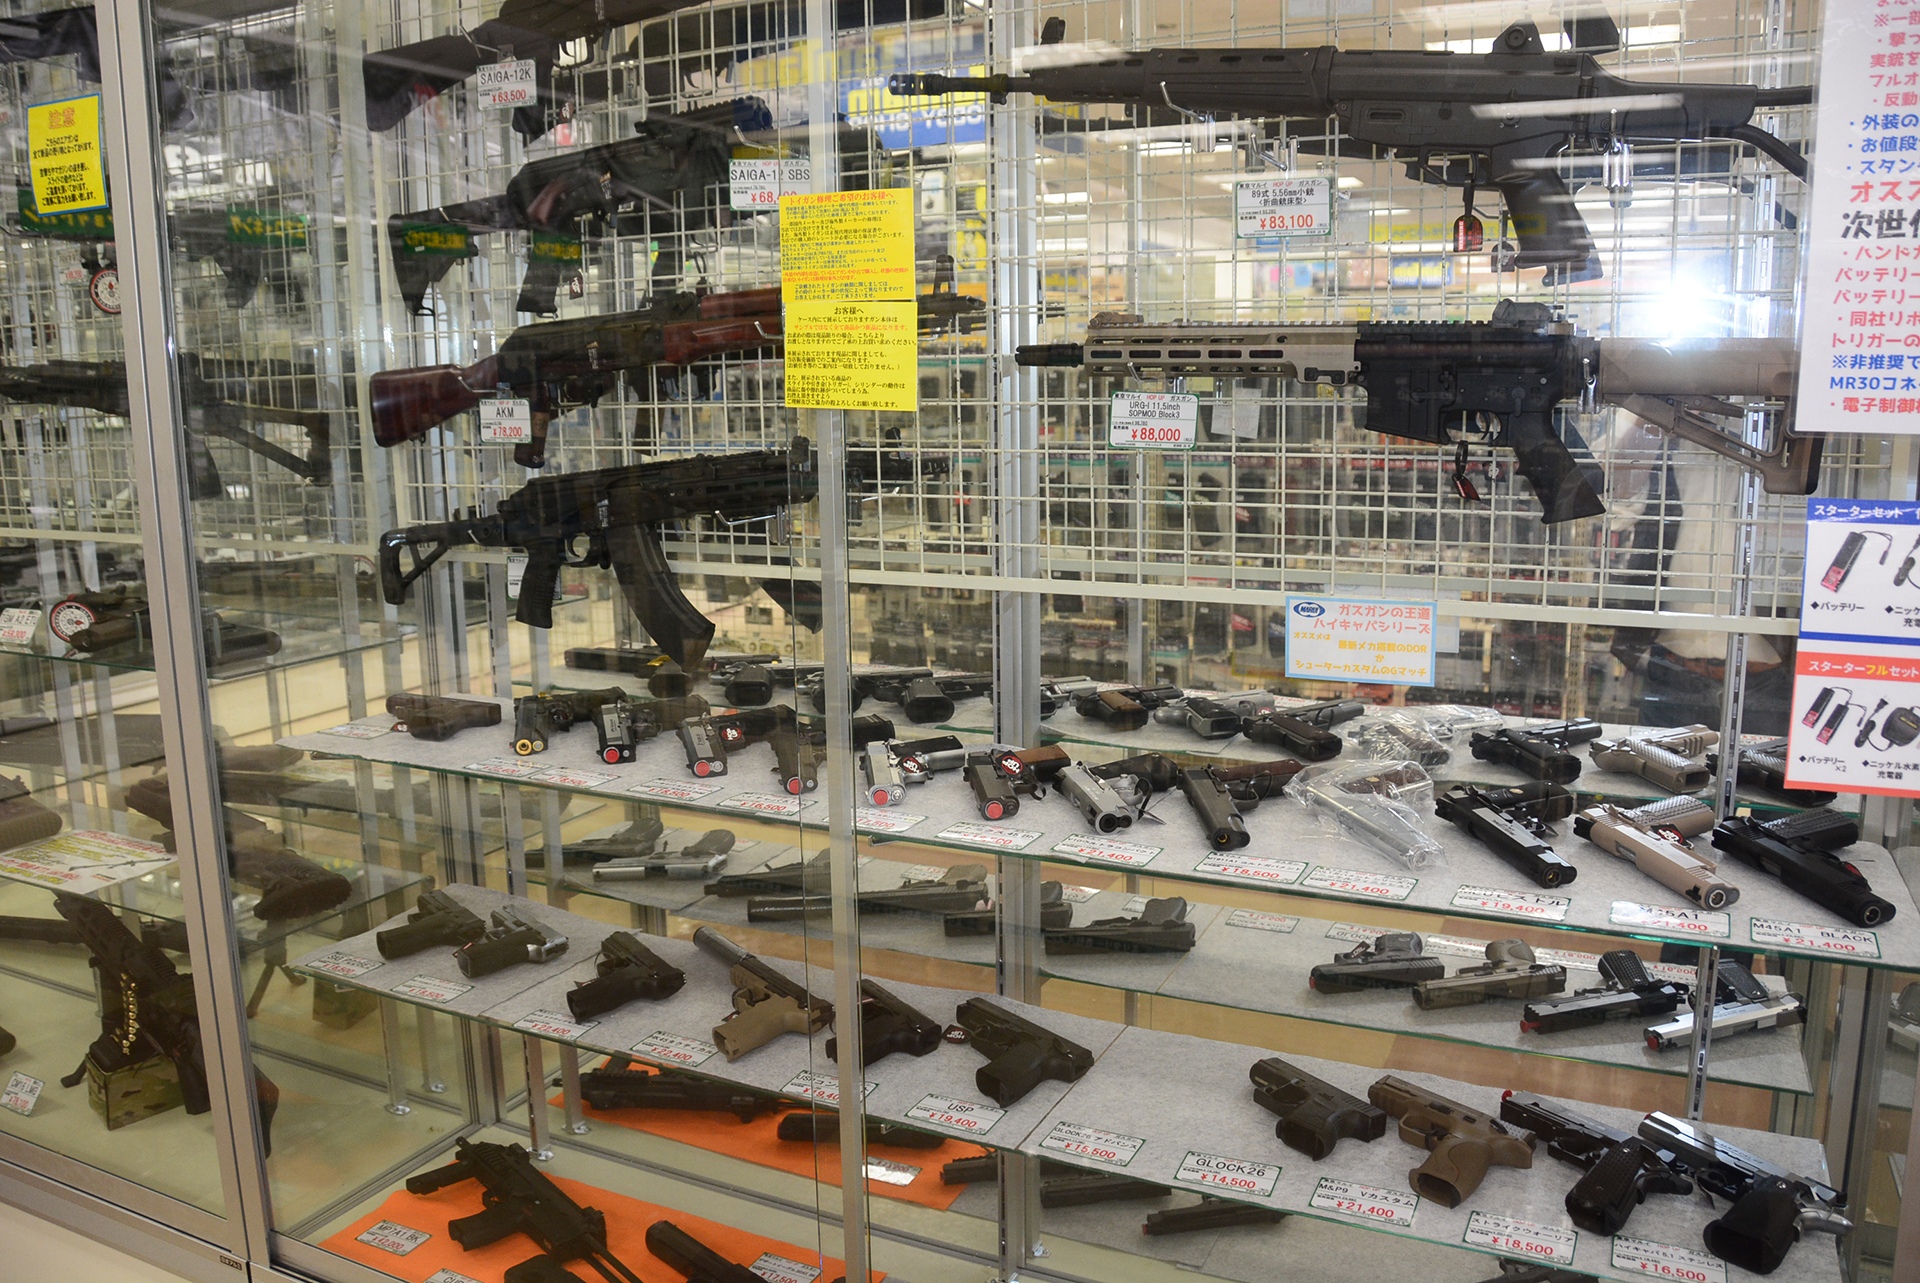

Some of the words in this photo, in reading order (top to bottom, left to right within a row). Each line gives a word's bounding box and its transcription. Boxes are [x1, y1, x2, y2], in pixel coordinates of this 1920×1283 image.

[481, 67, 531, 85] SAIGA-12K
[492, 89, 526, 103] ¥63,500
[49, 107, 75, 129] 注意
[788, 169, 810, 181] SBS
[790, 191, 894, 206] トイガン修理ご希望のお客様へ
[1252, 190, 1269, 198] 89式
[1260, 214, 1314, 230] ¥83,100
[834, 306, 864, 315] お客様へ
[1832, 332, 1920, 348] トリガーの
[496, 406, 515, 418] AKM
[1129, 401, 1150, 409] URG-I
[1152, 402, 1181, 411] 11.5inch
[493, 426, 523, 438] ¥78,200
[1132, 427, 1181, 442] ¥88,000
[1814, 504, 1903, 519] スターターセット
[1339, 604, 1430, 621] ガスガンの王道
[1820, 602, 1865, 612] バッテリー
[1313, 617, 1431, 635] ハイキャパシリーズ
[1294, 632, 1331, 641] オススメは
[1338, 639, 1428, 653] 最新メカ搭載のDOR
[1375, 653, 1385, 663] か
[1295, 659, 1427, 677] シューターカスタムのGマッチ
[1809, 660, 1920, 678] スターターフルセット
[1806, 756, 1845, 765] バッテリー
[1869, 760, 1920, 771] ニッケル水素
[1877, 770, 1903, 780] 充電器
[740, 801, 787, 811] ¥16,500
[1078, 848, 1133, 861] ¥21,400
[1221, 866, 1280, 879] ¥18,500
[1329, 881, 1389, 895] ¥21,400
[1480, 900, 1545, 914] ¥19,400
[1753, 922, 1801, 934] M45A1
[1820, 931, 1874, 943] BLACK
[1783, 937, 1856, 952] ¥21,400
[531, 1023, 571, 1036] ¥22,400
[651, 1046, 693, 1061] ¥22,400
[803, 1087, 839, 1101] ¥19,40
[947, 1103, 974, 1113] USP
[929, 1112, 977, 1128] ¥19,400
[1054, 1127, 1092, 1140] GLOCK26
[1094, 1136, 1137, 1150] アドバンス
[1065, 1142, 1116, 1159] ¥15,500
[1196, 1158, 1266, 1177] GLOCK26
[1201, 1173, 1256, 1189] ¥14,500
[1318, 1182, 1349, 1194] M&P9
[1360, 1190, 1414, 1207] Vカスタム
[1336, 1200, 1394, 1218] ¥21,400
[377, 1223, 407, 1238] MP7A1
[405, 1231, 422, 1243] BK
[1472, 1217, 1574, 1243] ストライクウォーリア
[372, 1235, 405, 1250] ¥42,000
[1492, 1235, 1554, 1256] ¥18,500
[1679, 1256, 1724, 1270] ステンレス
[1640, 1261, 1706, 1282] ¥16,500
